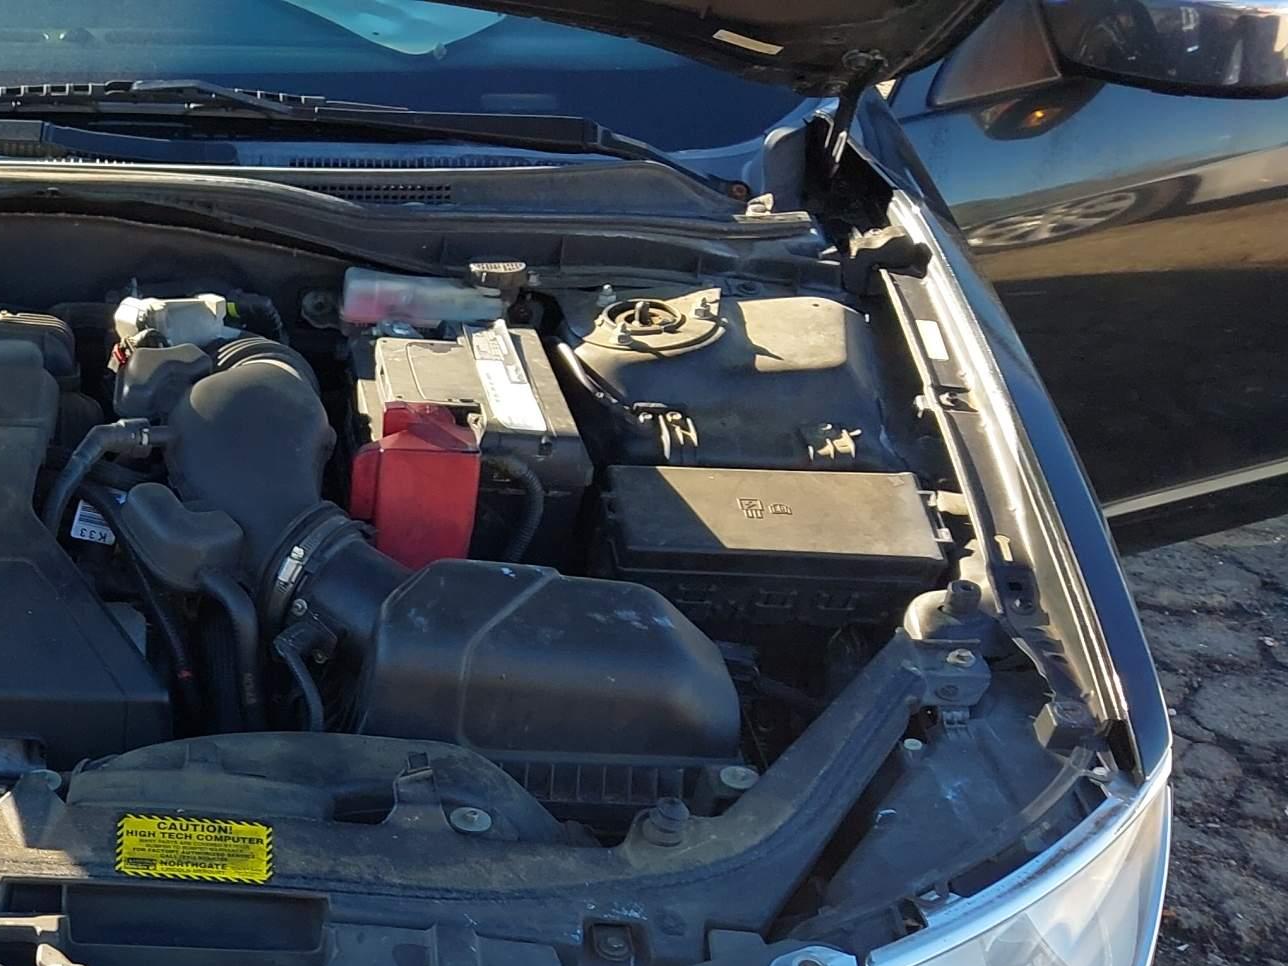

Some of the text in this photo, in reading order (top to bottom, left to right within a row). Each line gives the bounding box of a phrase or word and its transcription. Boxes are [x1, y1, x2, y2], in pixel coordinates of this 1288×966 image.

[79, 528, 108, 542] K33
[157, 821, 233, 835] CAUTION!
[125, 829, 156, 838] HIGH
[159, 831, 193, 840] TECH
[196, 834, 264, 845] COMPUTER
[159, 860, 227, 870] NORTHGATE
